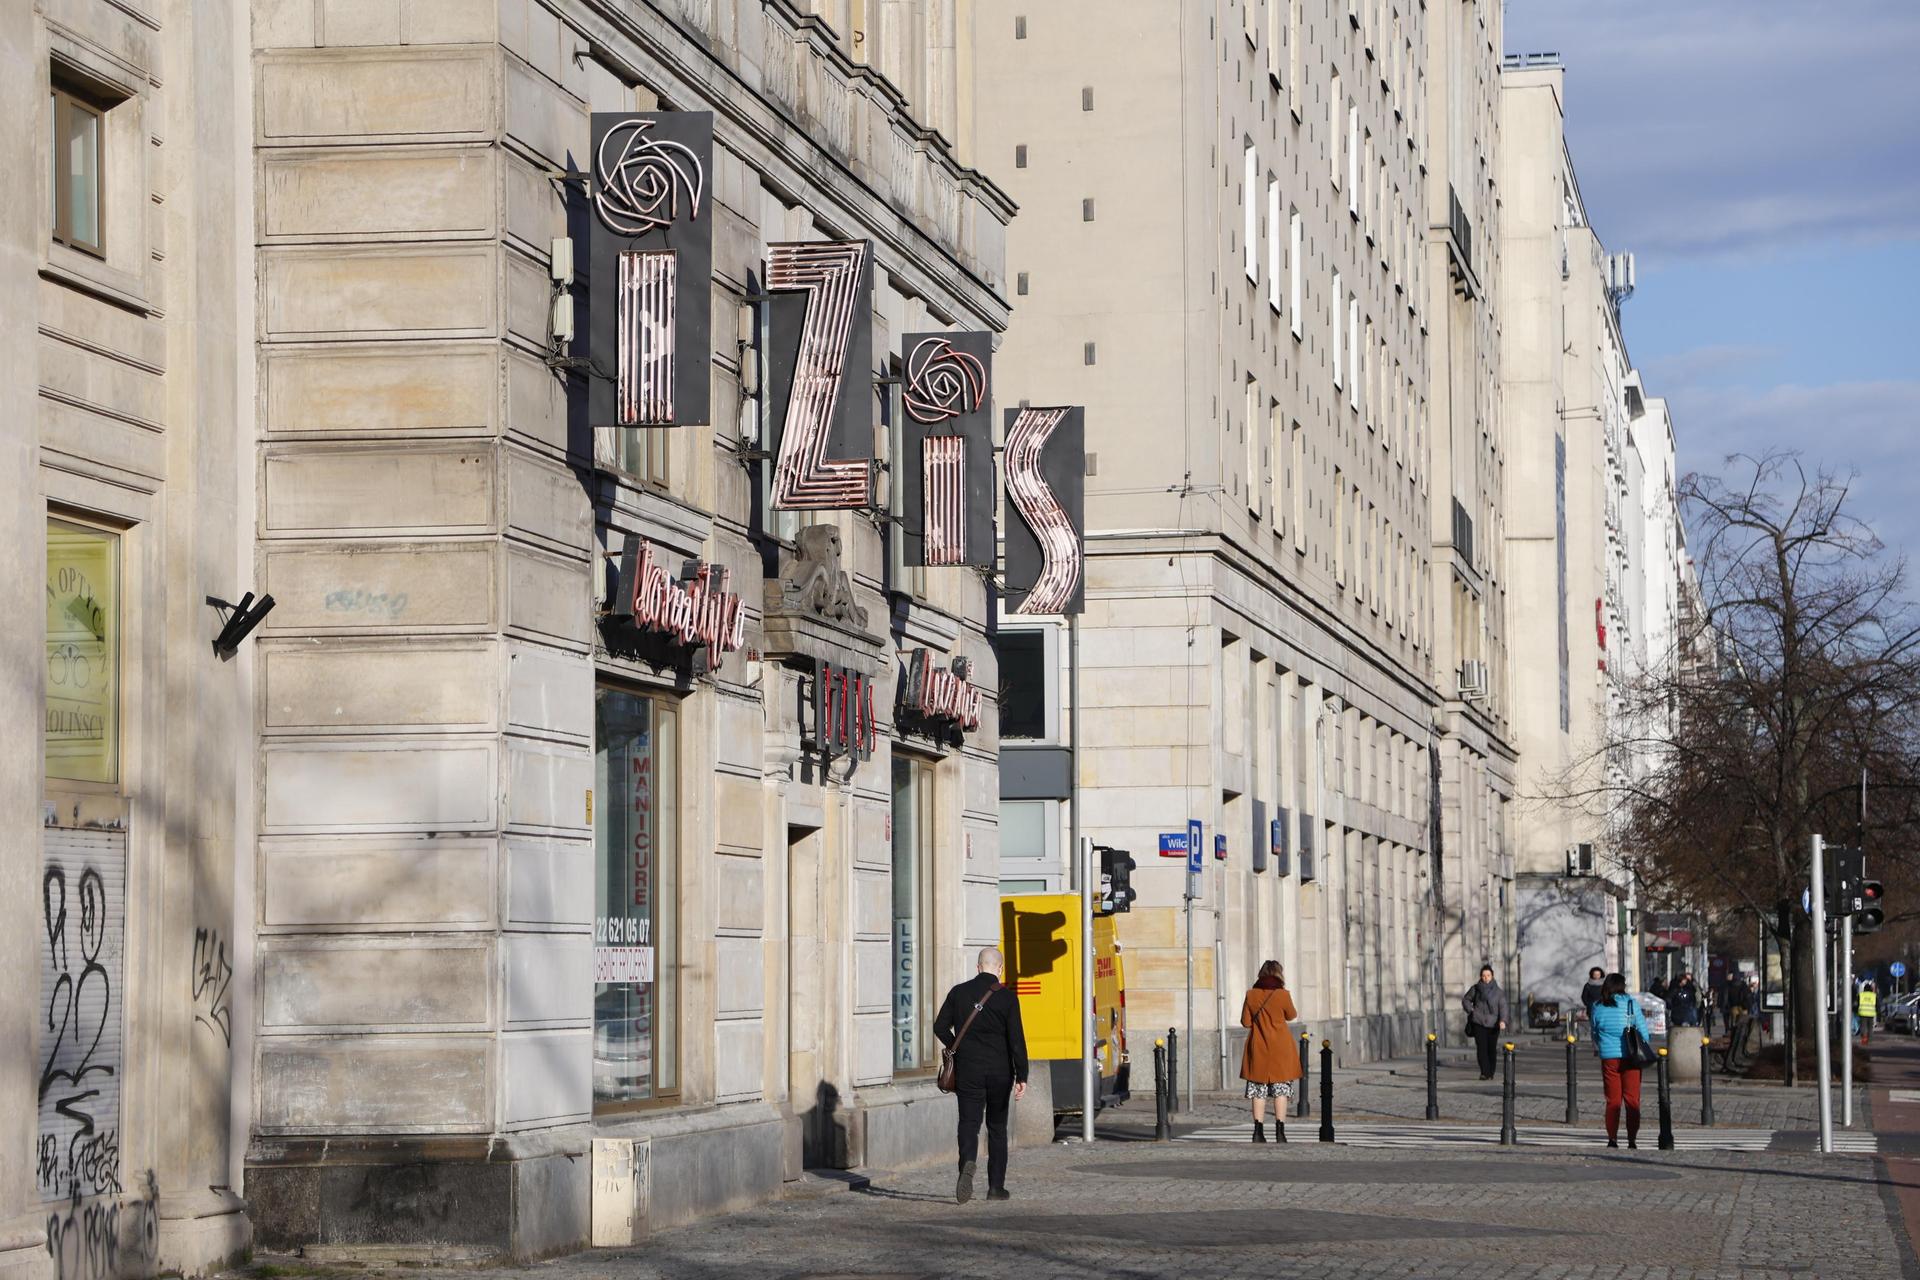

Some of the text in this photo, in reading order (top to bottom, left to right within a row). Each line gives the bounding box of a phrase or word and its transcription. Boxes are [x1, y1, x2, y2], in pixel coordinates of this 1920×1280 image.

[633, 757, 650, 907] MANICURE
[596, 917, 650, 943] 22 621 05 07
[901, 923, 913, 1062] LECZNICA
